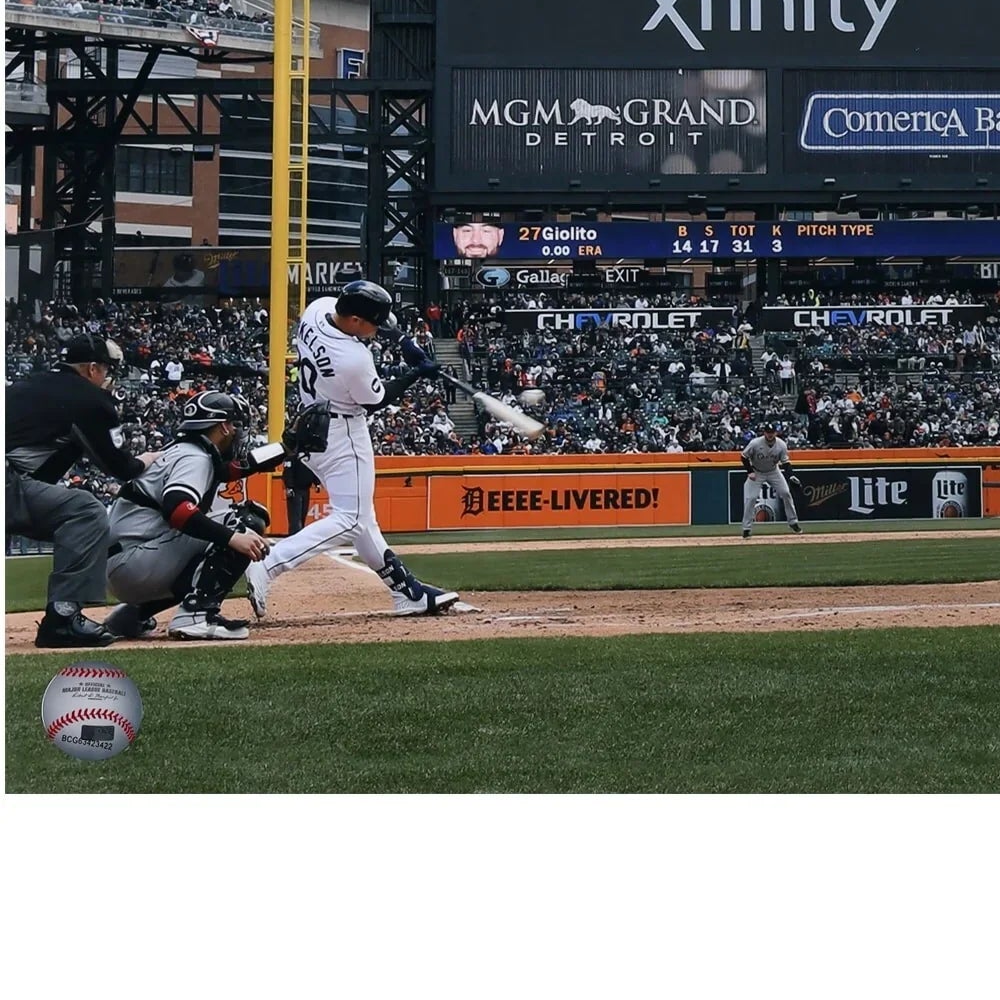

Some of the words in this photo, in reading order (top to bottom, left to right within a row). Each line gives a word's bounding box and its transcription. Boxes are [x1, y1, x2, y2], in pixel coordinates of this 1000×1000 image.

[470, 98, 569, 127] MGM
[526, 131, 704, 147] DETROIT
[519, 227, 539, 240] 27
[541, 227, 597, 241] Giolito
[730, 225, 756, 236] TOT
[798, 225, 837, 236] PITCH
[840, 225, 874, 236] TYPE
[578, 245, 602, 256] ERA
[605, 269, 639, 283] EXIT
[537, 312, 702, 330] CHEVROLET
[793, 310, 953, 327] CHEVROLET
[847, 476, 908, 515] Lite
[937, 480, 964, 499] Lite
